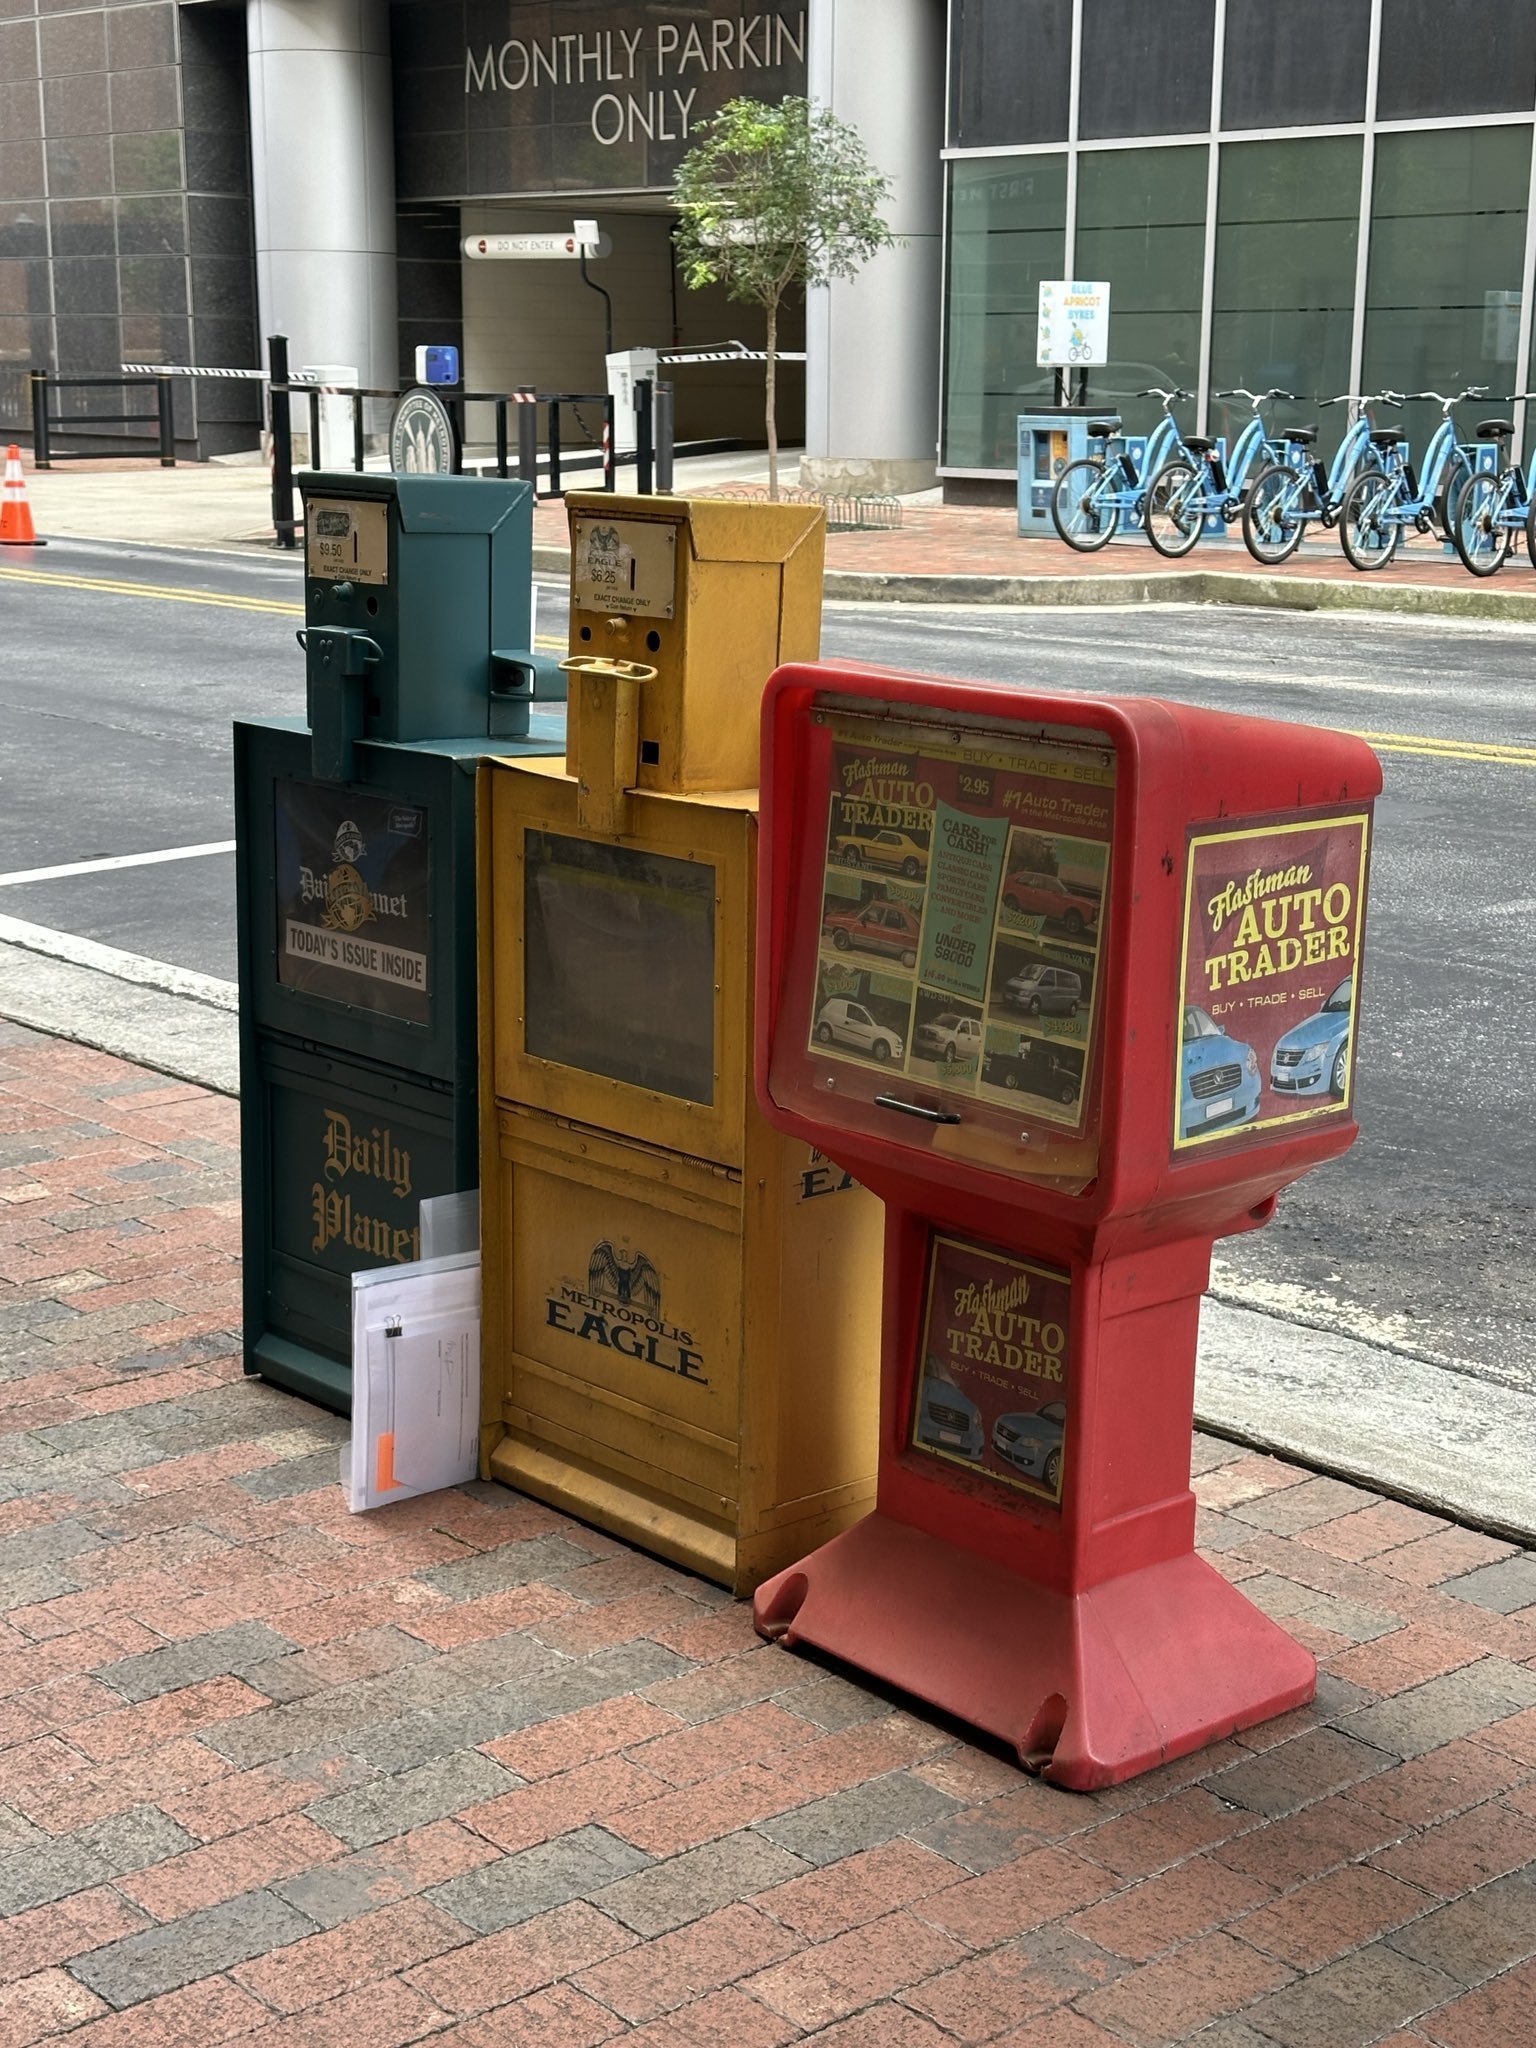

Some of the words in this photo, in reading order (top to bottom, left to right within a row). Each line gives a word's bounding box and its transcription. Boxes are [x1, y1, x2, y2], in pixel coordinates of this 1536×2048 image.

[465, 27, 643, 93] MONTHLY
[657, 11, 806, 77] PARKIN
[591, 87, 698, 145] ONLY
[497, 240, 509, 251] DO
[512, 240, 528, 250] NOT
[530, 240, 554, 250] ENTER
[1063, 296, 1101, 306] APRICOT
[1072, 284, 1093, 294] BLUE
[319, 542, 342, 557] $9.50
[588, 556, 622, 568] EAGLE
[323, 565, 339, 573] EXACT
[339, 566, 360, 576] CHANGE
[591, 568, 616, 584] $6.25
[593, 593, 612, 602] EXACT
[612, 596, 635, 606] CHANGE
[842, 756, 911, 788] Flashman
[963, 751, 994, 764] BUY
[1009, 756, 1058, 775] TRADE
[1073, 766, 1107, 783] SELL
[860, 777, 935, 809] AUTO
[958, 774, 991, 796] $2.95
[840, 801, 934, 832] TRADER
[1002, 789, 1023, 810] #1
[1022, 791, 1058, 811] Auto
[1061, 797, 1110, 819] Trader
[942, 818, 980, 841] CARS
[981, 833, 998, 846] FOR
[946, 833, 989, 857] CASH!
[937, 850, 972, 866] ANTIQUE
[937, 861, 970, 876] CLASSIC
[299, 866, 329, 904] Dai
[1208, 862, 1313, 932] Flashman
[1233, 881, 1351, 948] AUTO
[290, 927, 339, 961] TODAY'S
[342, 940, 378, 973] ISSUE
[381, 951, 423, 984] INSIDE
[934, 946, 974, 968] $8000
[935, 932, 977, 955] UNDER
[1205, 925, 1351, 991] TRADER
[1212, 1000, 1236, 1016] BUY
[1247, 991, 1288, 1009] TRADE
[1298, 986, 1326, 1001] SELL
[322, 1108, 413, 1200] Daily
[312, 1182, 421, 1264] Planet
[954, 1274, 1030, 1317] Flashman
[560, 1286, 694, 1347] METROPOLIS
[970, 1306, 1065, 1355] AUTO
[546, 1298, 709, 1386] EAGLE
[946, 1328, 1064, 1383] TRADER
[950, 1360, 969, 1373] BUY
[978, 1370, 1009, 1390] TRADE
[1017, 1384, 1040, 1400] SELL
